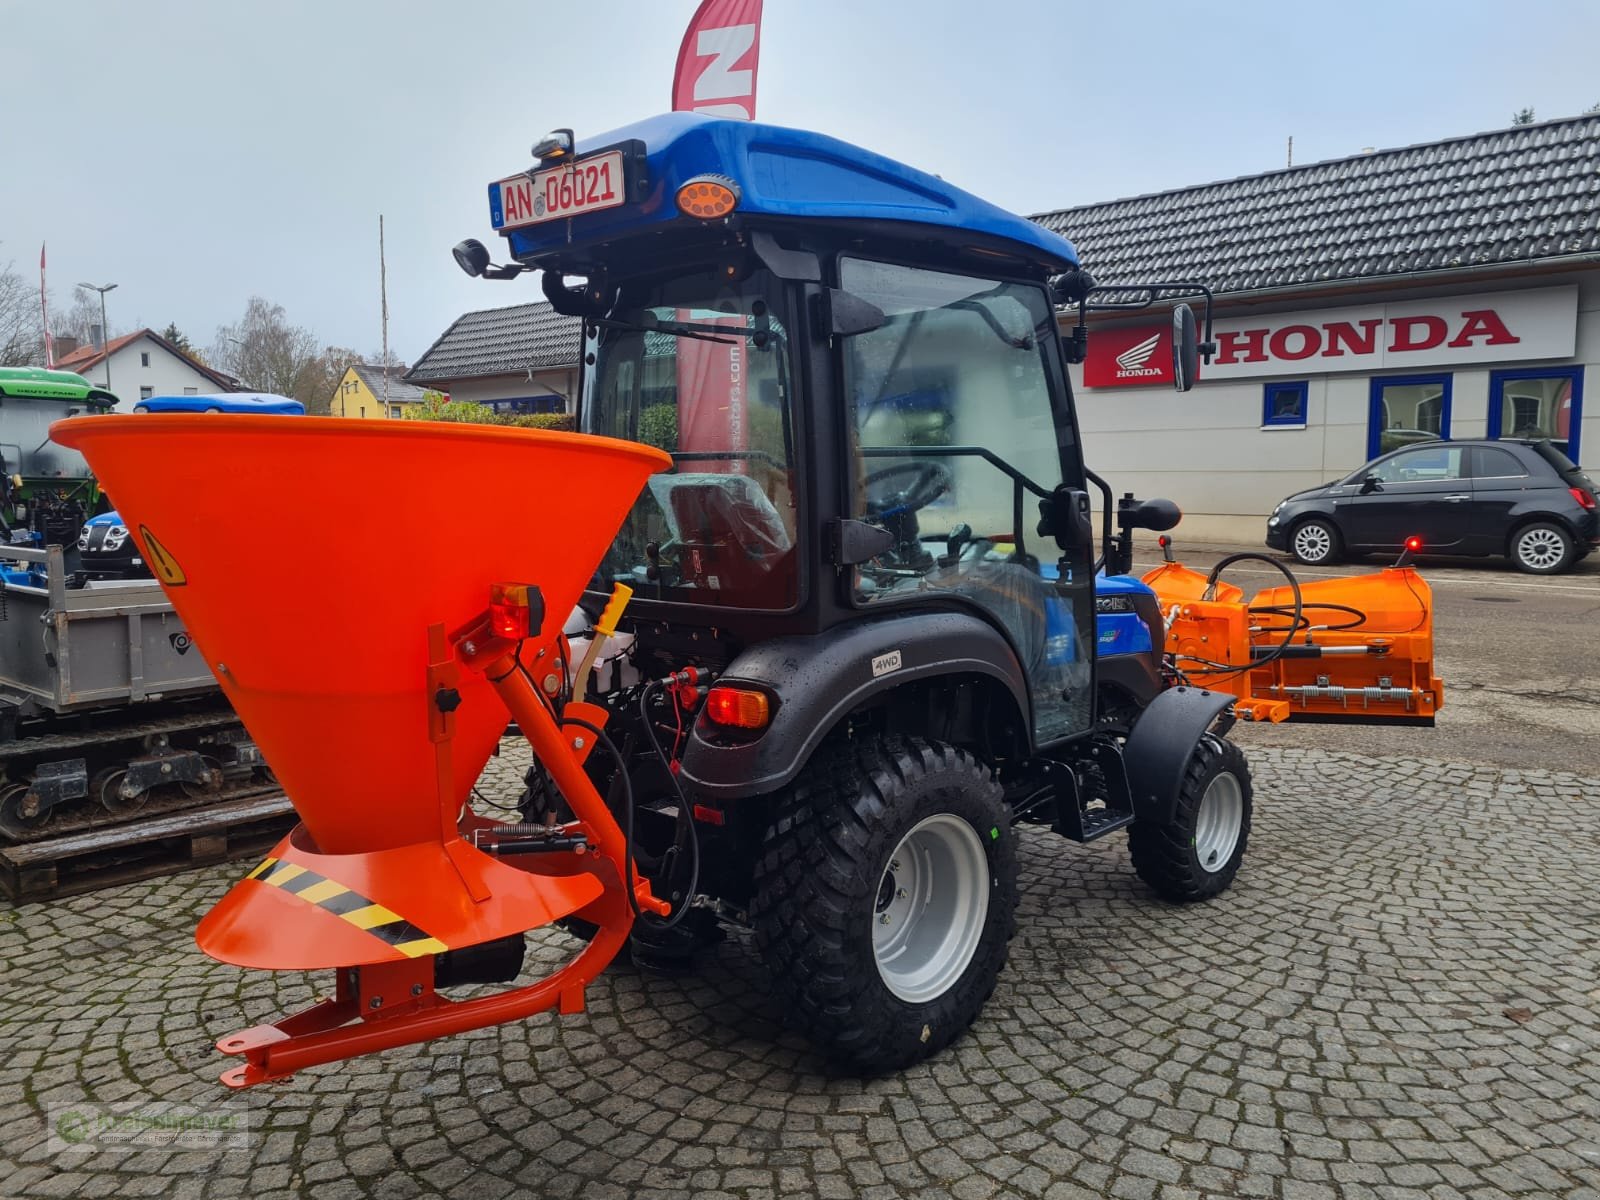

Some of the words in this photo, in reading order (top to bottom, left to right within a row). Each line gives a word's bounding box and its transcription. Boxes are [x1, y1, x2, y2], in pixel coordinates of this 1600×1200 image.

[504, 182, 533, 222] AN
[546, 161, 615, 213] 06021
[1213, 309, 1521, 365] HONDA
[1115, 367, 1163, 378] HONDA
[875, 655, 898, 671] 4WD
